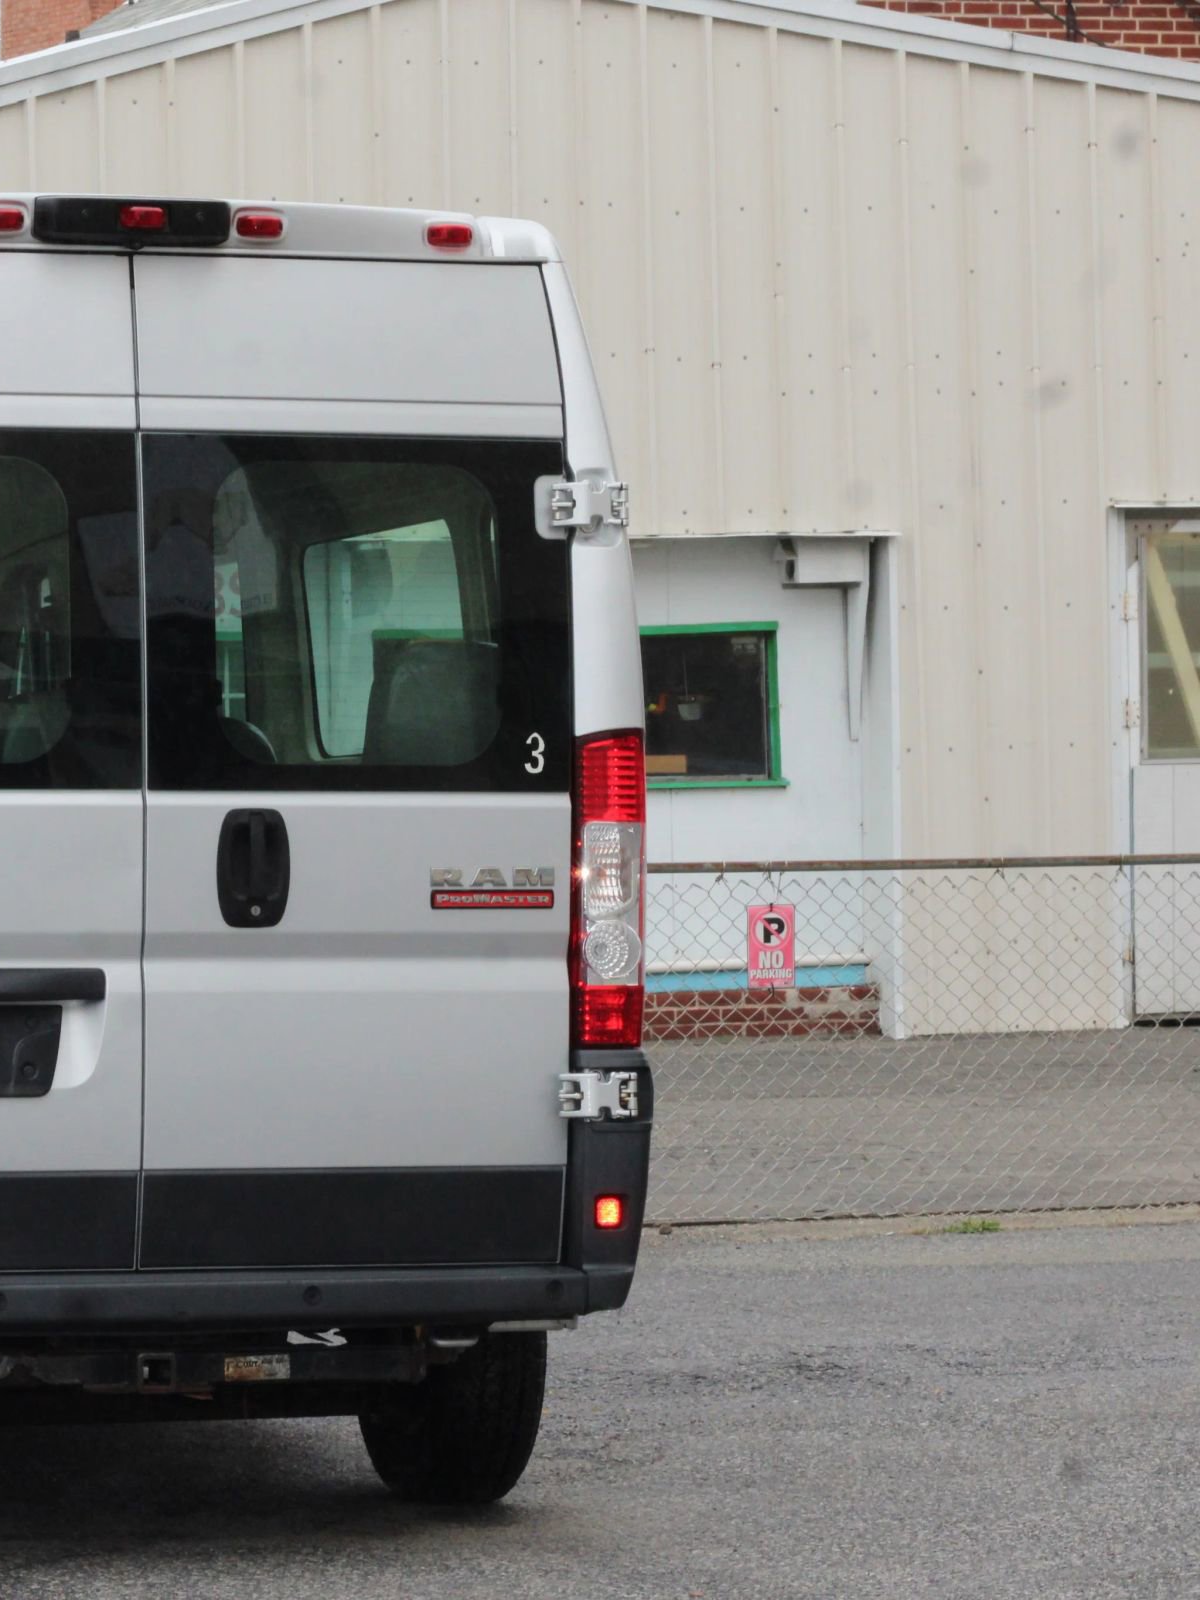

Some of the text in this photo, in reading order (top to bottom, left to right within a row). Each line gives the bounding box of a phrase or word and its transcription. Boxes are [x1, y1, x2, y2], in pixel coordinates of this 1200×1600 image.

[524, 732, 545, 774] 3
[430, 866, 556, 888] RAM
[758, 950, 785, 969] NO
[750, 968, 793, 979] PARKING
